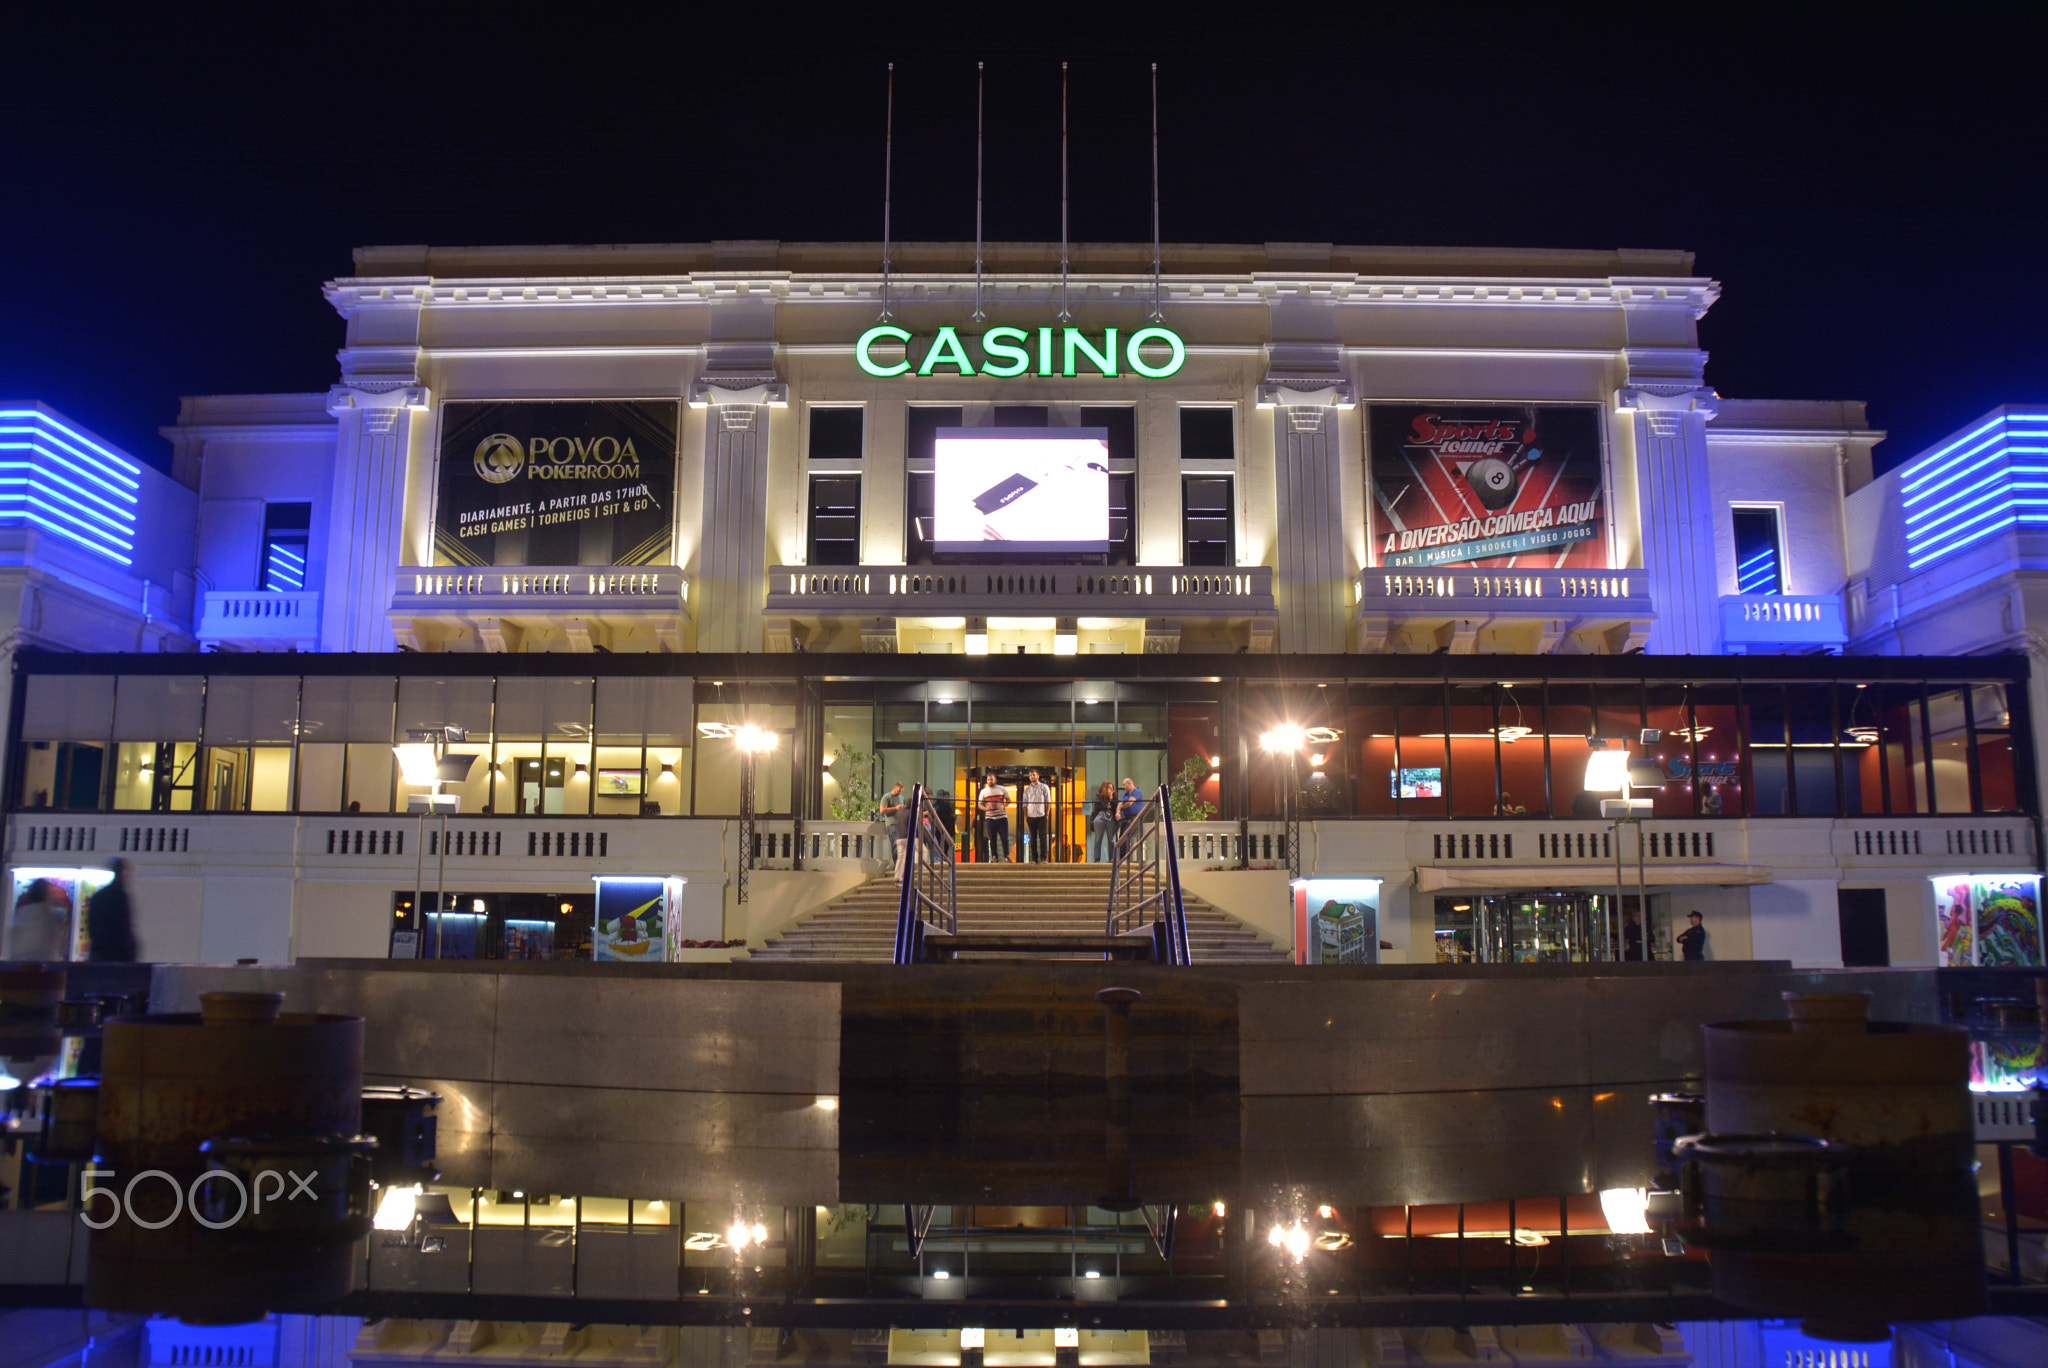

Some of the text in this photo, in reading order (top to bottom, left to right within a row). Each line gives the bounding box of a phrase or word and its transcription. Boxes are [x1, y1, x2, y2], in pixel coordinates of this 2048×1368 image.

[855, 325, 1185, 378] CASINO
[1406, 413, 1516, 444] Sports
[529, 436, 639, 464] POVOA
[1439, 441, 1505, 454] LOUNGE
[528, 464, 639, 479] POKERROOM
[460, 503, 535, 524] DIARIAMENTE,
[539, 501, 546, 511] A
[549, 494, 587, 510] PARTIR
[591, 491, 612, 504] DAS
[460, 522, 487, 538] CASH
[491, 517, 526, 533] GAMES
[539, 508, 590, 526] TORNEIOS
[602, 502, 619, 516] SIT
[623, 502, 631, 512] &
[634, 499, 648, 511] GO
[1384, 501, 1596, 553] A DIVERSÃO COMEÇA AQUI
[1395, 557, 1414, 566] BAR
[1427, 548, 1463, 561] MÚSICA
[1475, 539, 1518, 554] SNOOKER
[1531, 533, 1558, 544] VIDEO
[1563, 527, 1591, 540] JOGOS
